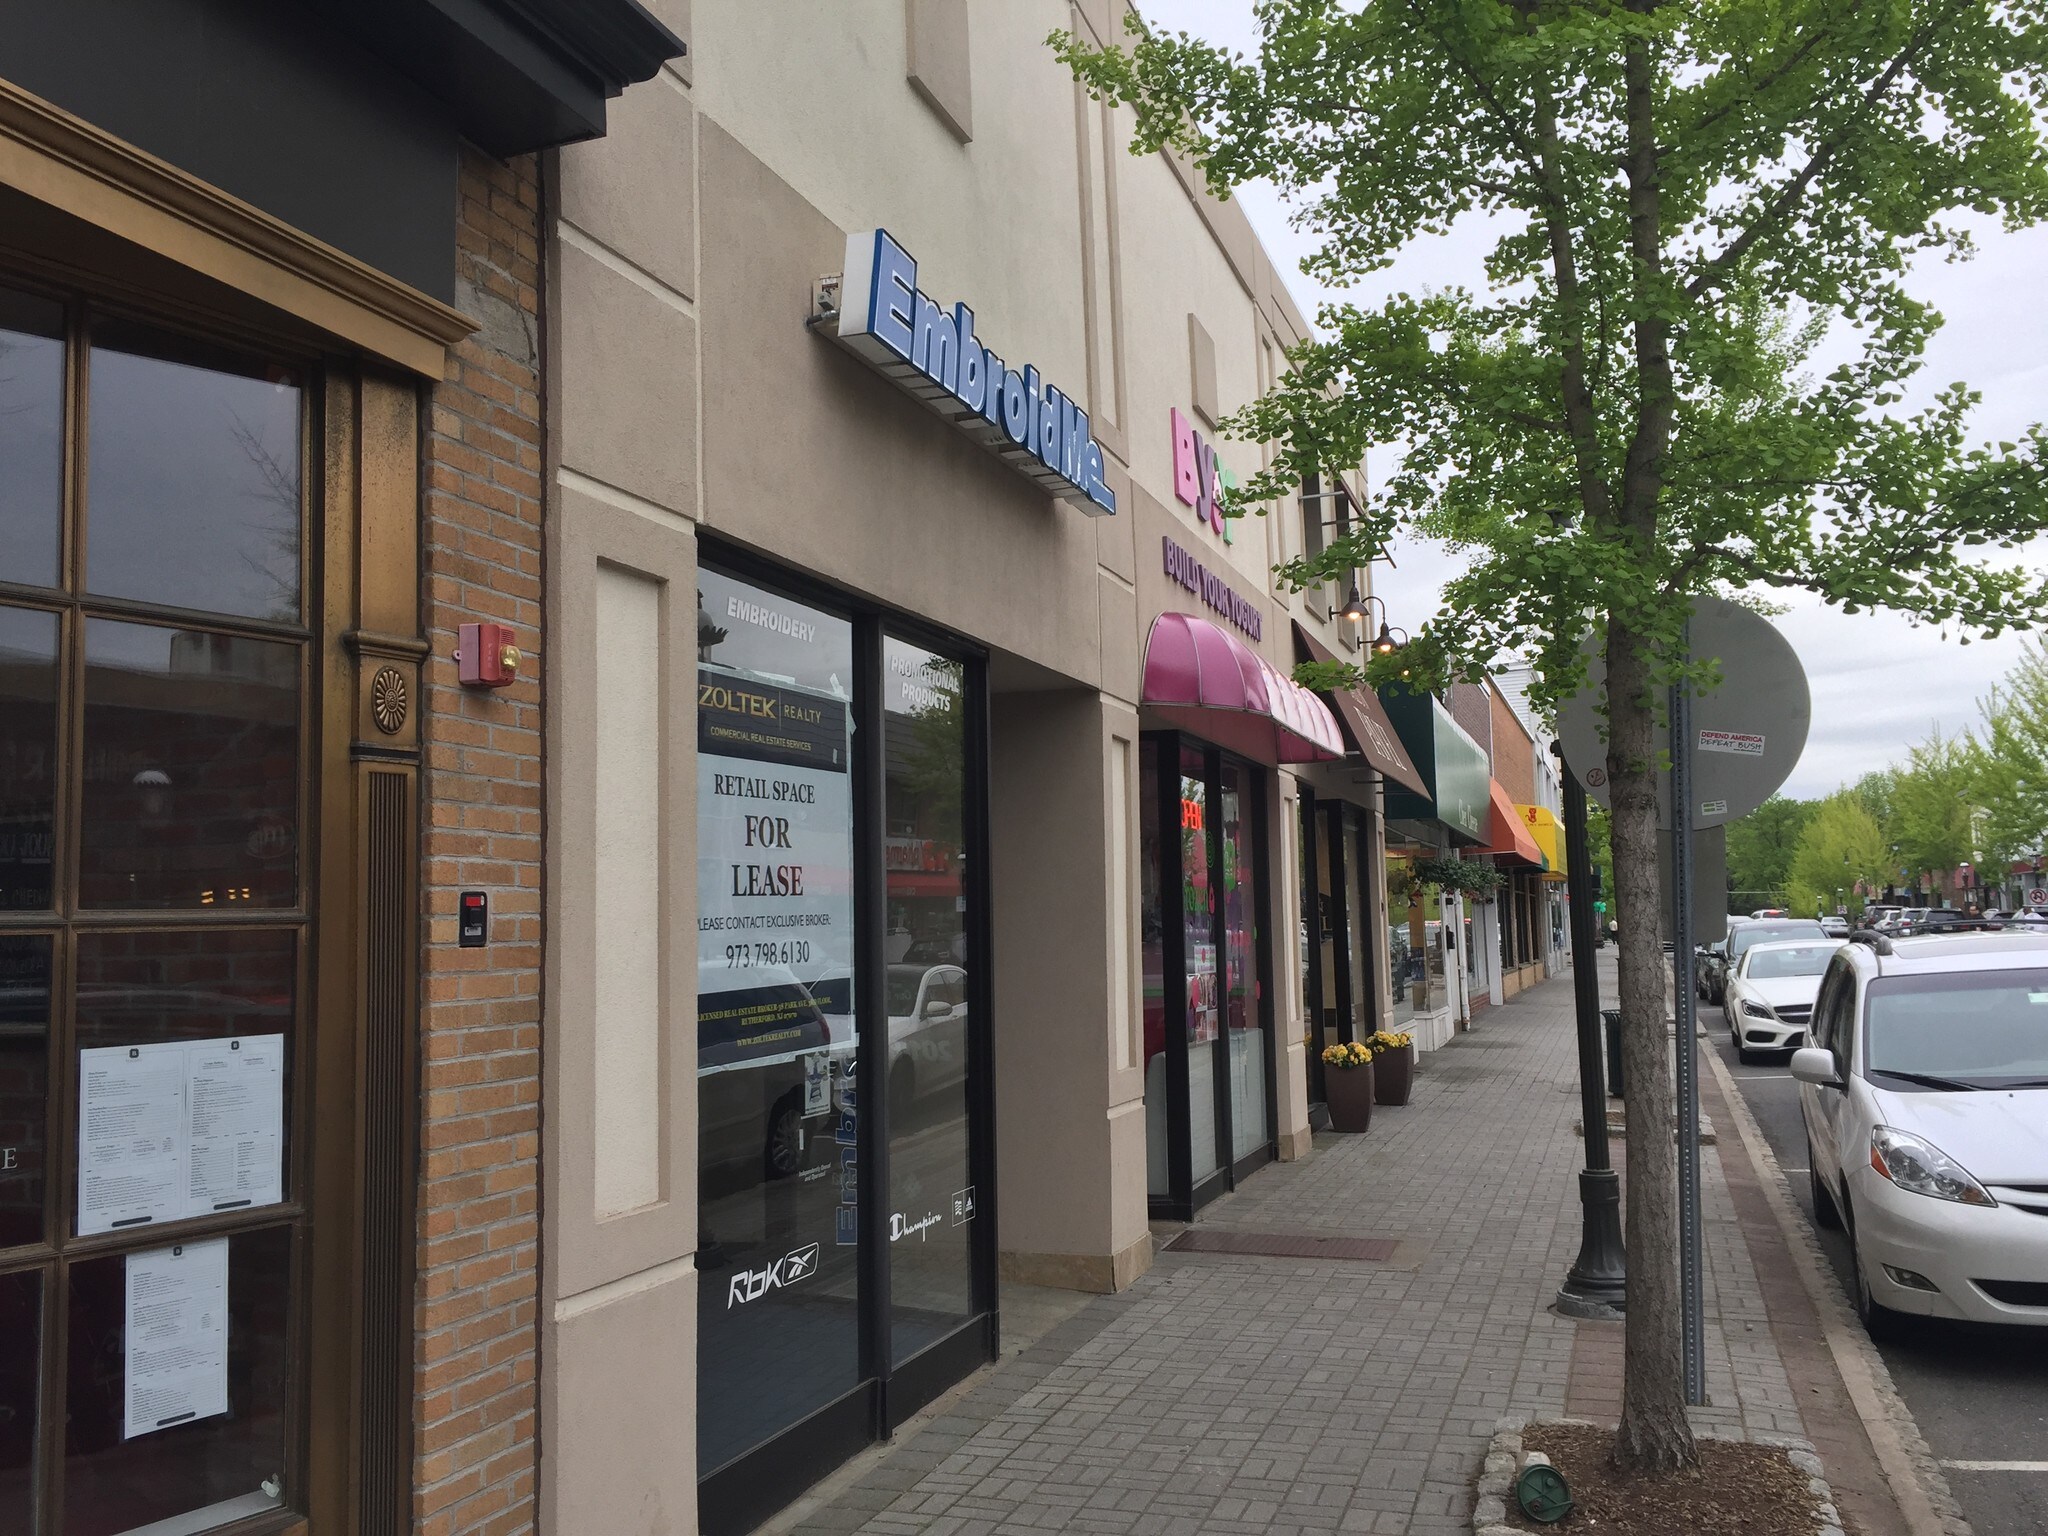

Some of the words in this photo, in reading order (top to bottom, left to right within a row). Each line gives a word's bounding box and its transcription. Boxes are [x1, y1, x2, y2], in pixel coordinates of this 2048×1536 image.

[867, 228, 1116, 515] EmbroidMe
[1162, 536, 1199, 594] BUILD
[1198, 564, 1228, 618] YOUR
[1227, 588, 1262, 643] YOGURT
[727, 597, 816, 642] EMBROIDERY
[889, 655, 960, 694] PROMOTIONAL
[698, 685, 776, 719] ZOLTEK
[784, 704, 821, 724] REALTY
[901, 681, 951, 712] PRODUCTS
[710, 726, 751, 742] COMMERCIAL
[750, 733, 766, 744] REAL
[766, 736, 786, 748] ESTATE
[786, 739, 812, 752] SERVICES
[1700, 738, 1734, 748] DEFEAT
[1737, 741, 1762, 750] BUSH
[1701, 731, 1729, 740] DEFEND
[1730, 734, 1763, 743] AMERICA
[714, 773, 770, 800] RETAIL
[772, 780, 816, 804] SPACE
[744, 814, 793, 849] FOR
[731, 864, 804, 897] LEASE
[697, 917, 725, 931] LEASE
[725, 915, 766, 930] CONTACT
[766, 914, 804, 928] EXCLUSIVE
[725, 940, 810, 969] 973.798.6130
[889, 1211, 943, 1243] Champion
